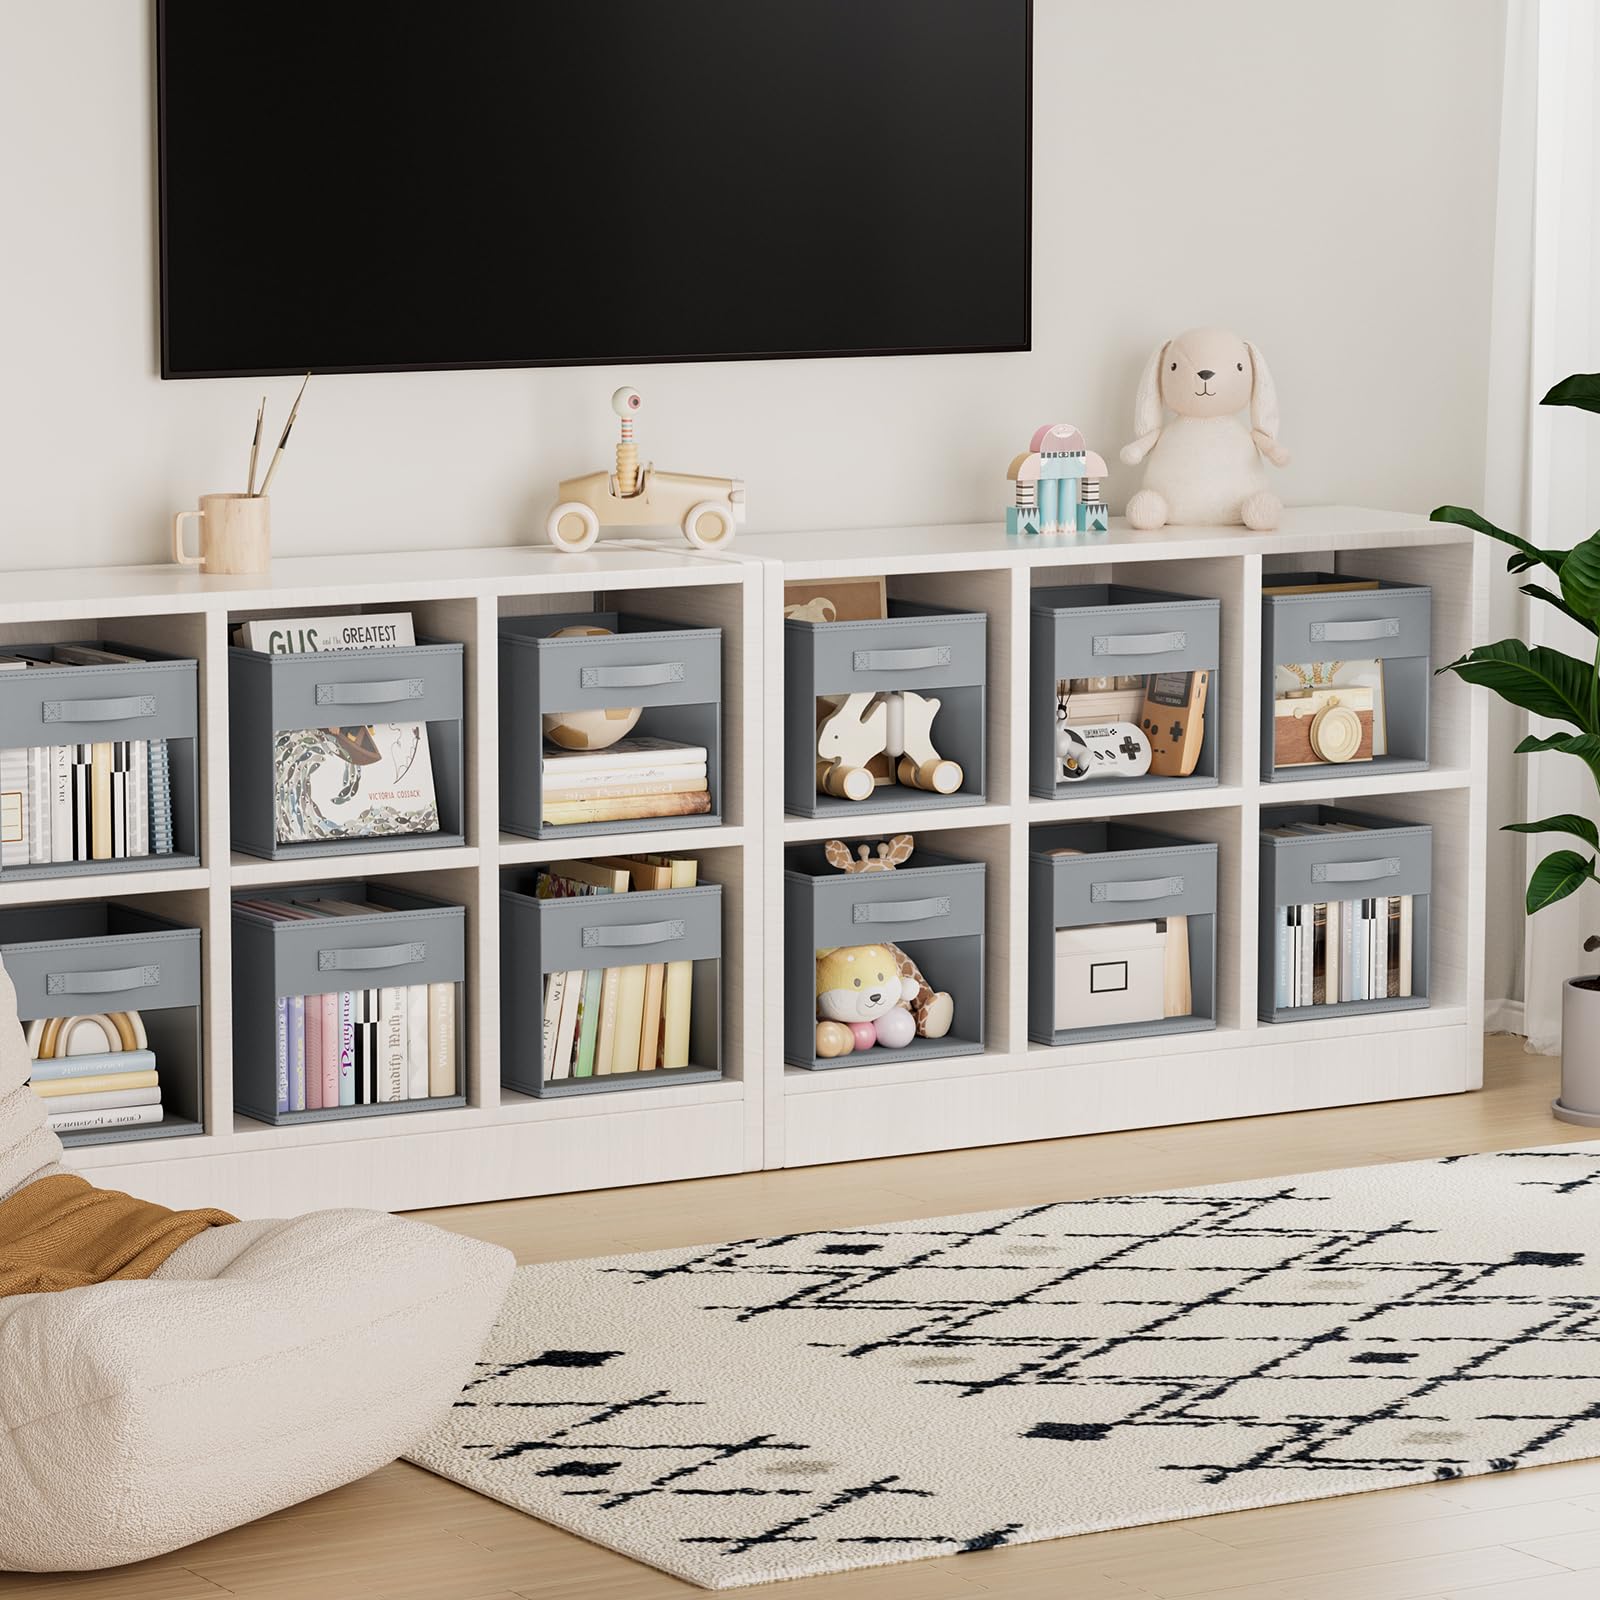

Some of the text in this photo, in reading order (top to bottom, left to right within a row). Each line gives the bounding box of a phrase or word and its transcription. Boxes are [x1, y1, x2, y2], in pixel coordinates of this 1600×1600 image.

[269, 628, 318, 654] GUS
[342, 625, 396, 644] GREATEST
[368, 789, 421, 800] VICTORIA COSSACK
